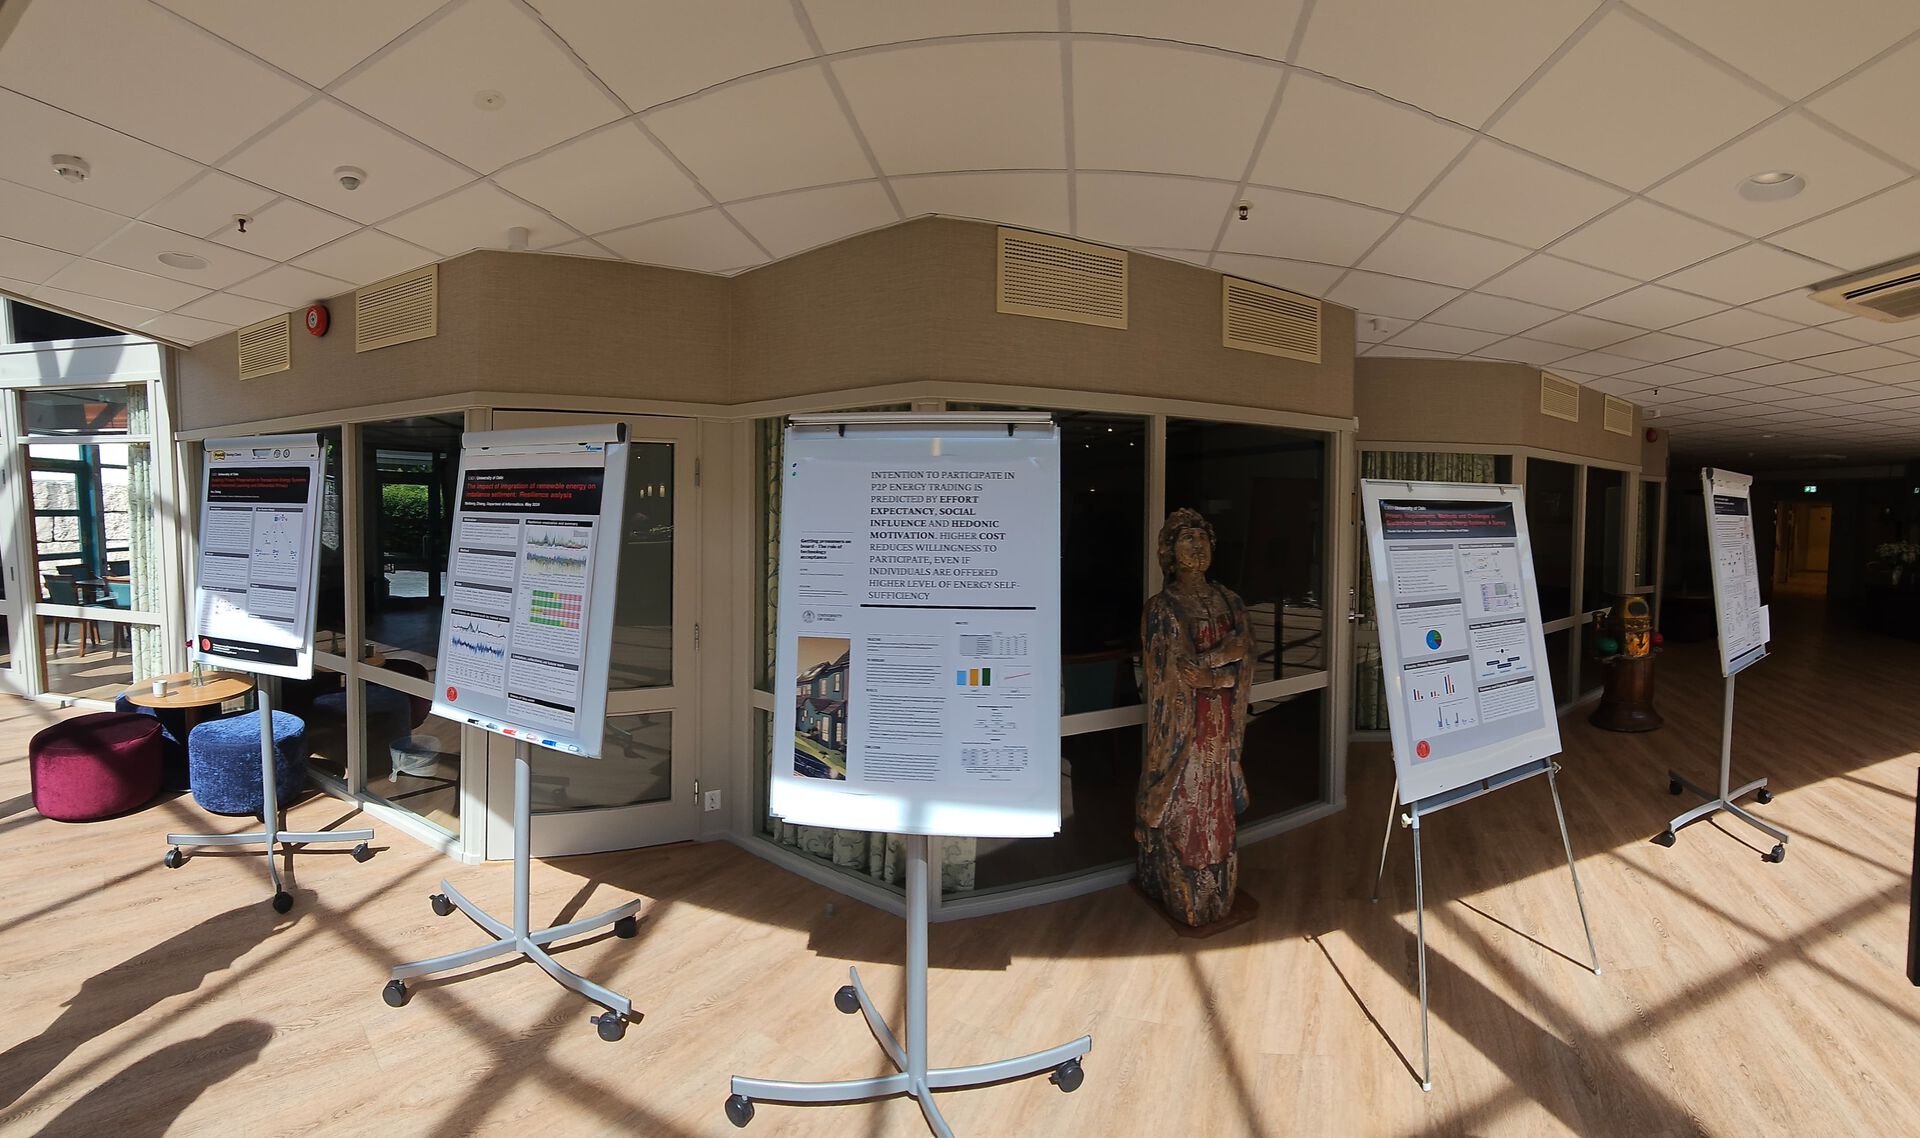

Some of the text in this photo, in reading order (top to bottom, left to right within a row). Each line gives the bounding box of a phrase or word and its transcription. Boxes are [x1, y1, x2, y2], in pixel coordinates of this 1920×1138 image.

[871, 471, 1015, 479] INTENTION TO PARTICIPATE IN
[871, 483, 983, 491] P2P ENERGY TRADING IS
[870, 495, 979, 504] PREDICTED BY EFFORT
[870, 507, 976, 516] EXPECTANCY, SOCIAL
[870, 519, 999, 528] INFLUENCE AND HEDONIC
[939, 531, 978, 540] HIGHER
[979, 531, 1006, 540] COST
[870, 544, 997, 552] REDUCES WILLINGNESS TO
[869, 556, 971, 565] PARTICIPATE, EVEN IF
[869, 568, 998, 577] INDIVIDUALS ARE OFFERED
[869, 579, 1021, 589] HIGHER LEVEL OF ENERGY SELF-
[868, 591, 930, 600] SUFFICIENCY
